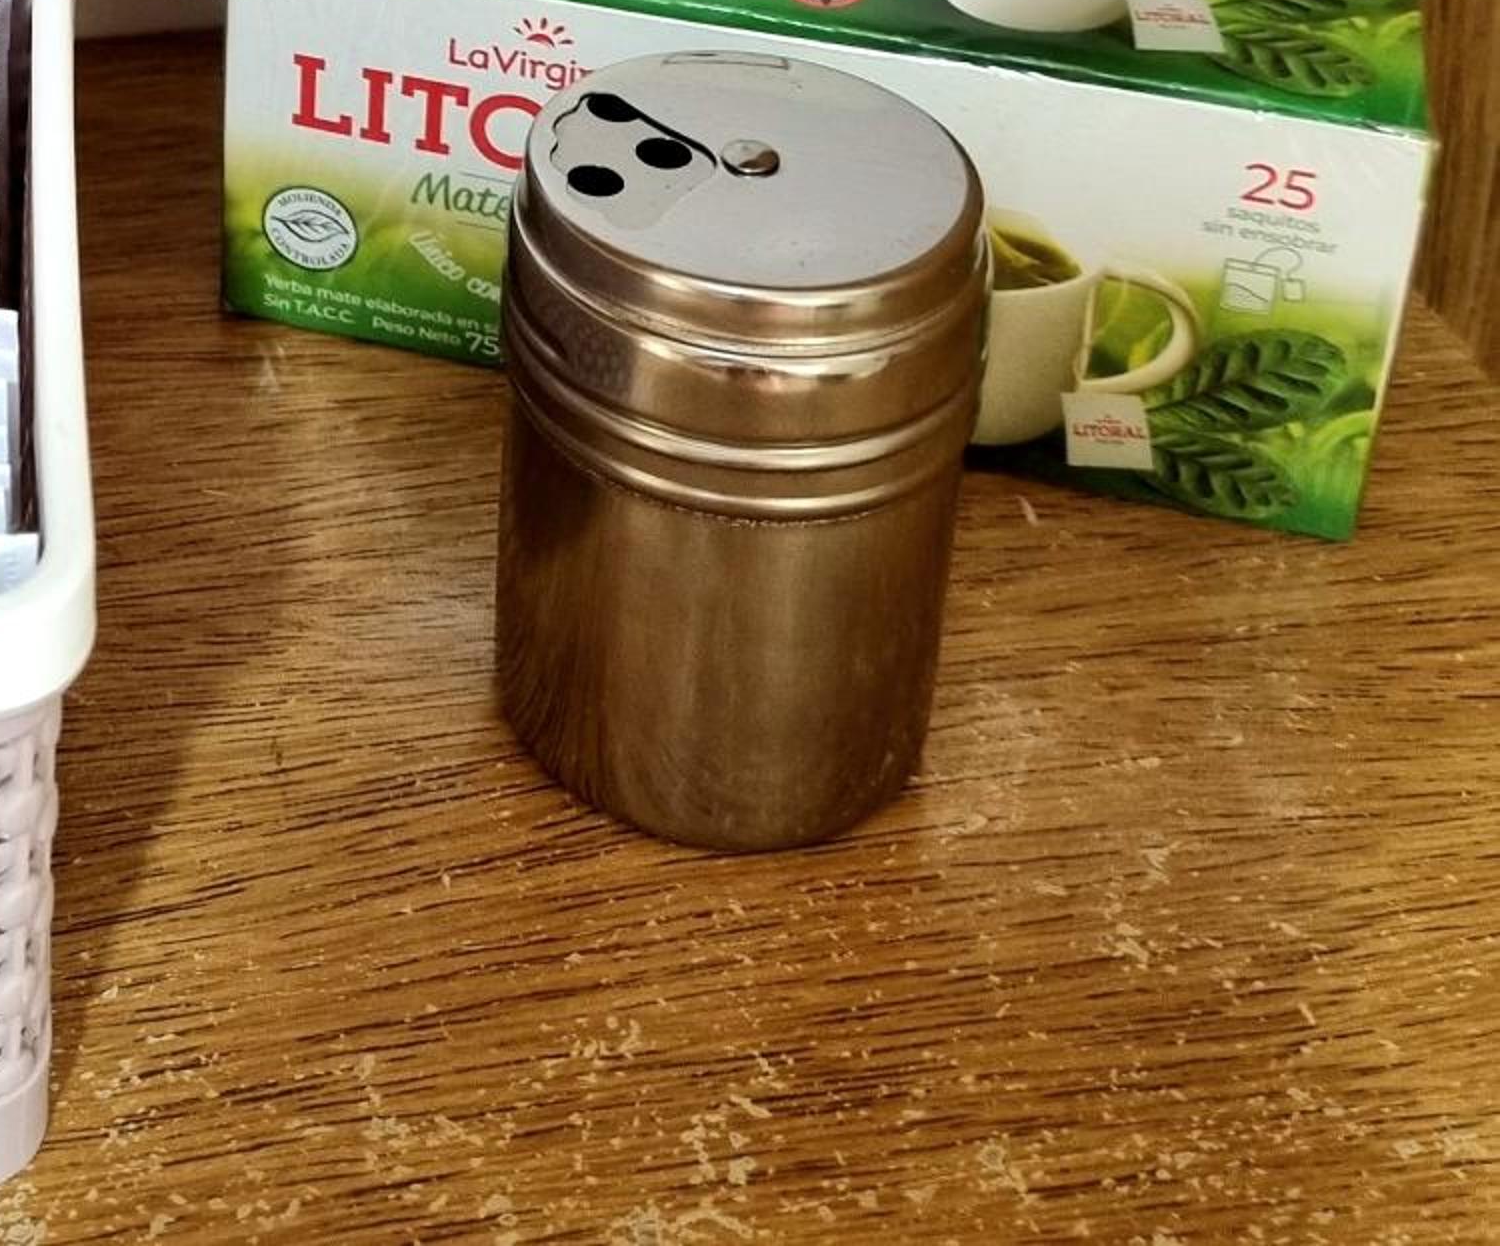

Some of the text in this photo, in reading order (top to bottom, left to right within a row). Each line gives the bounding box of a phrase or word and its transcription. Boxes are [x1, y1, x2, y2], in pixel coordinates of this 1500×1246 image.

[449, 37, 593, 91] LaVirgi
[291, 52, 545, 171] LITO
[410, 172, 510, 223] Mate
[1240, 163, 1317, 210] 25
[1202, 221, 1338, 253] sin ensobrar
[1227, 207, 1321, 234] saquitos
[262, 273, 313, 296] Yerba
[316, 287, 362, 306] mate
[365, 298, 452, 325] elaborada
[455, 316, 480, 331] en
[262, 292, 291, 310] Sin
[372, 315, 415, 337] Peso
[419, 324, 462, 345] Neto
[465, 331, 501, 356] 75
